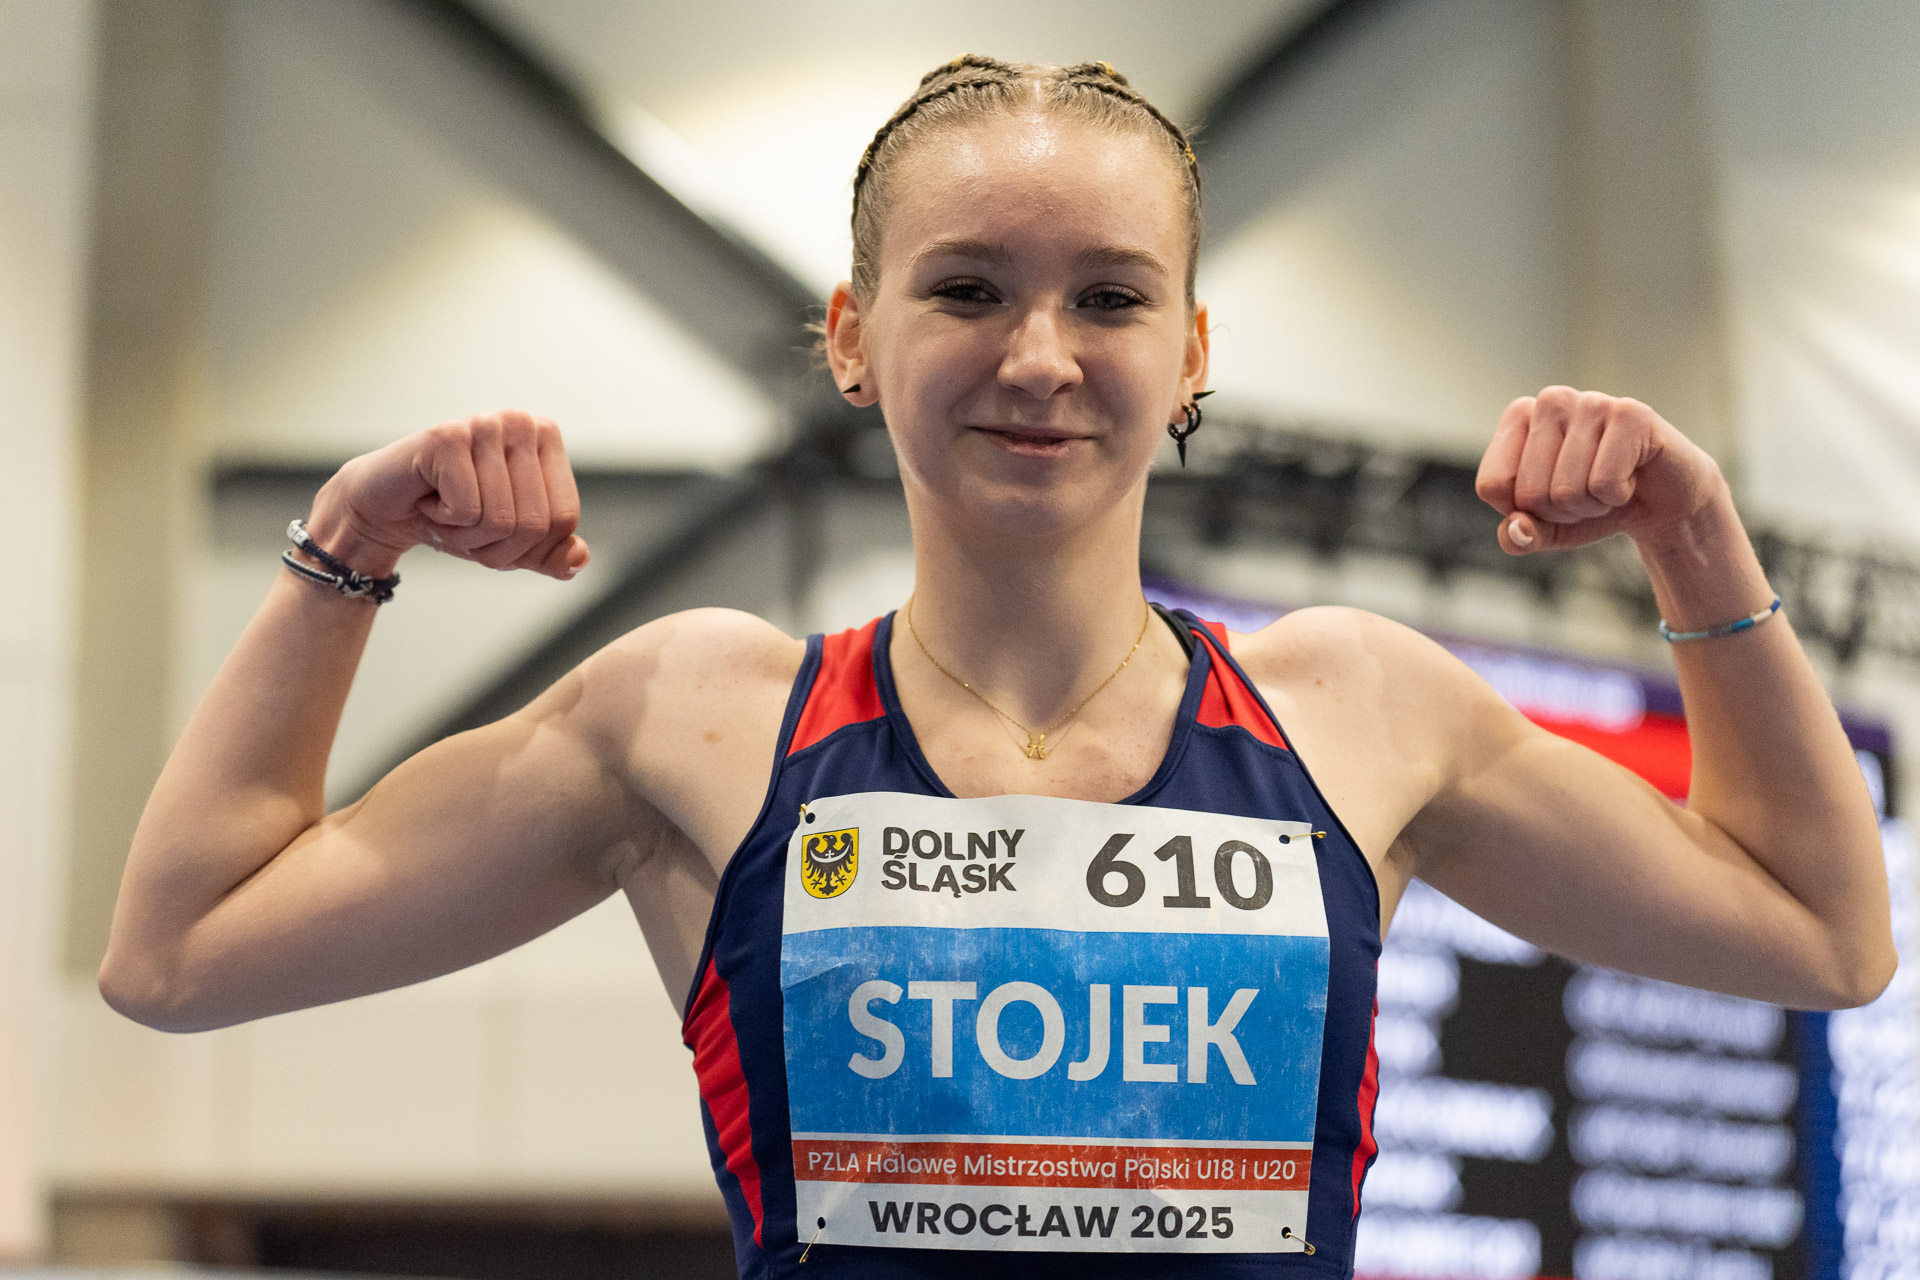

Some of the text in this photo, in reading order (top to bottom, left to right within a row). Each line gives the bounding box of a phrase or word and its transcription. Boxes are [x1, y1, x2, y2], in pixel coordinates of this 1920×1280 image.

[882, 826, 1026, 861] DOLNY
[881, 852, 1017, 899] ŚLĄSK
[1086, 833, 1274, 911] 610
[847, 980, 1260, 1086] STOJEK
[808, 1151, 1296, 1181] PZLA Halowe Mistrzostwa Polski U18 i U20
[868, 1200, 1234, 1239] WROCŁAW 2025
